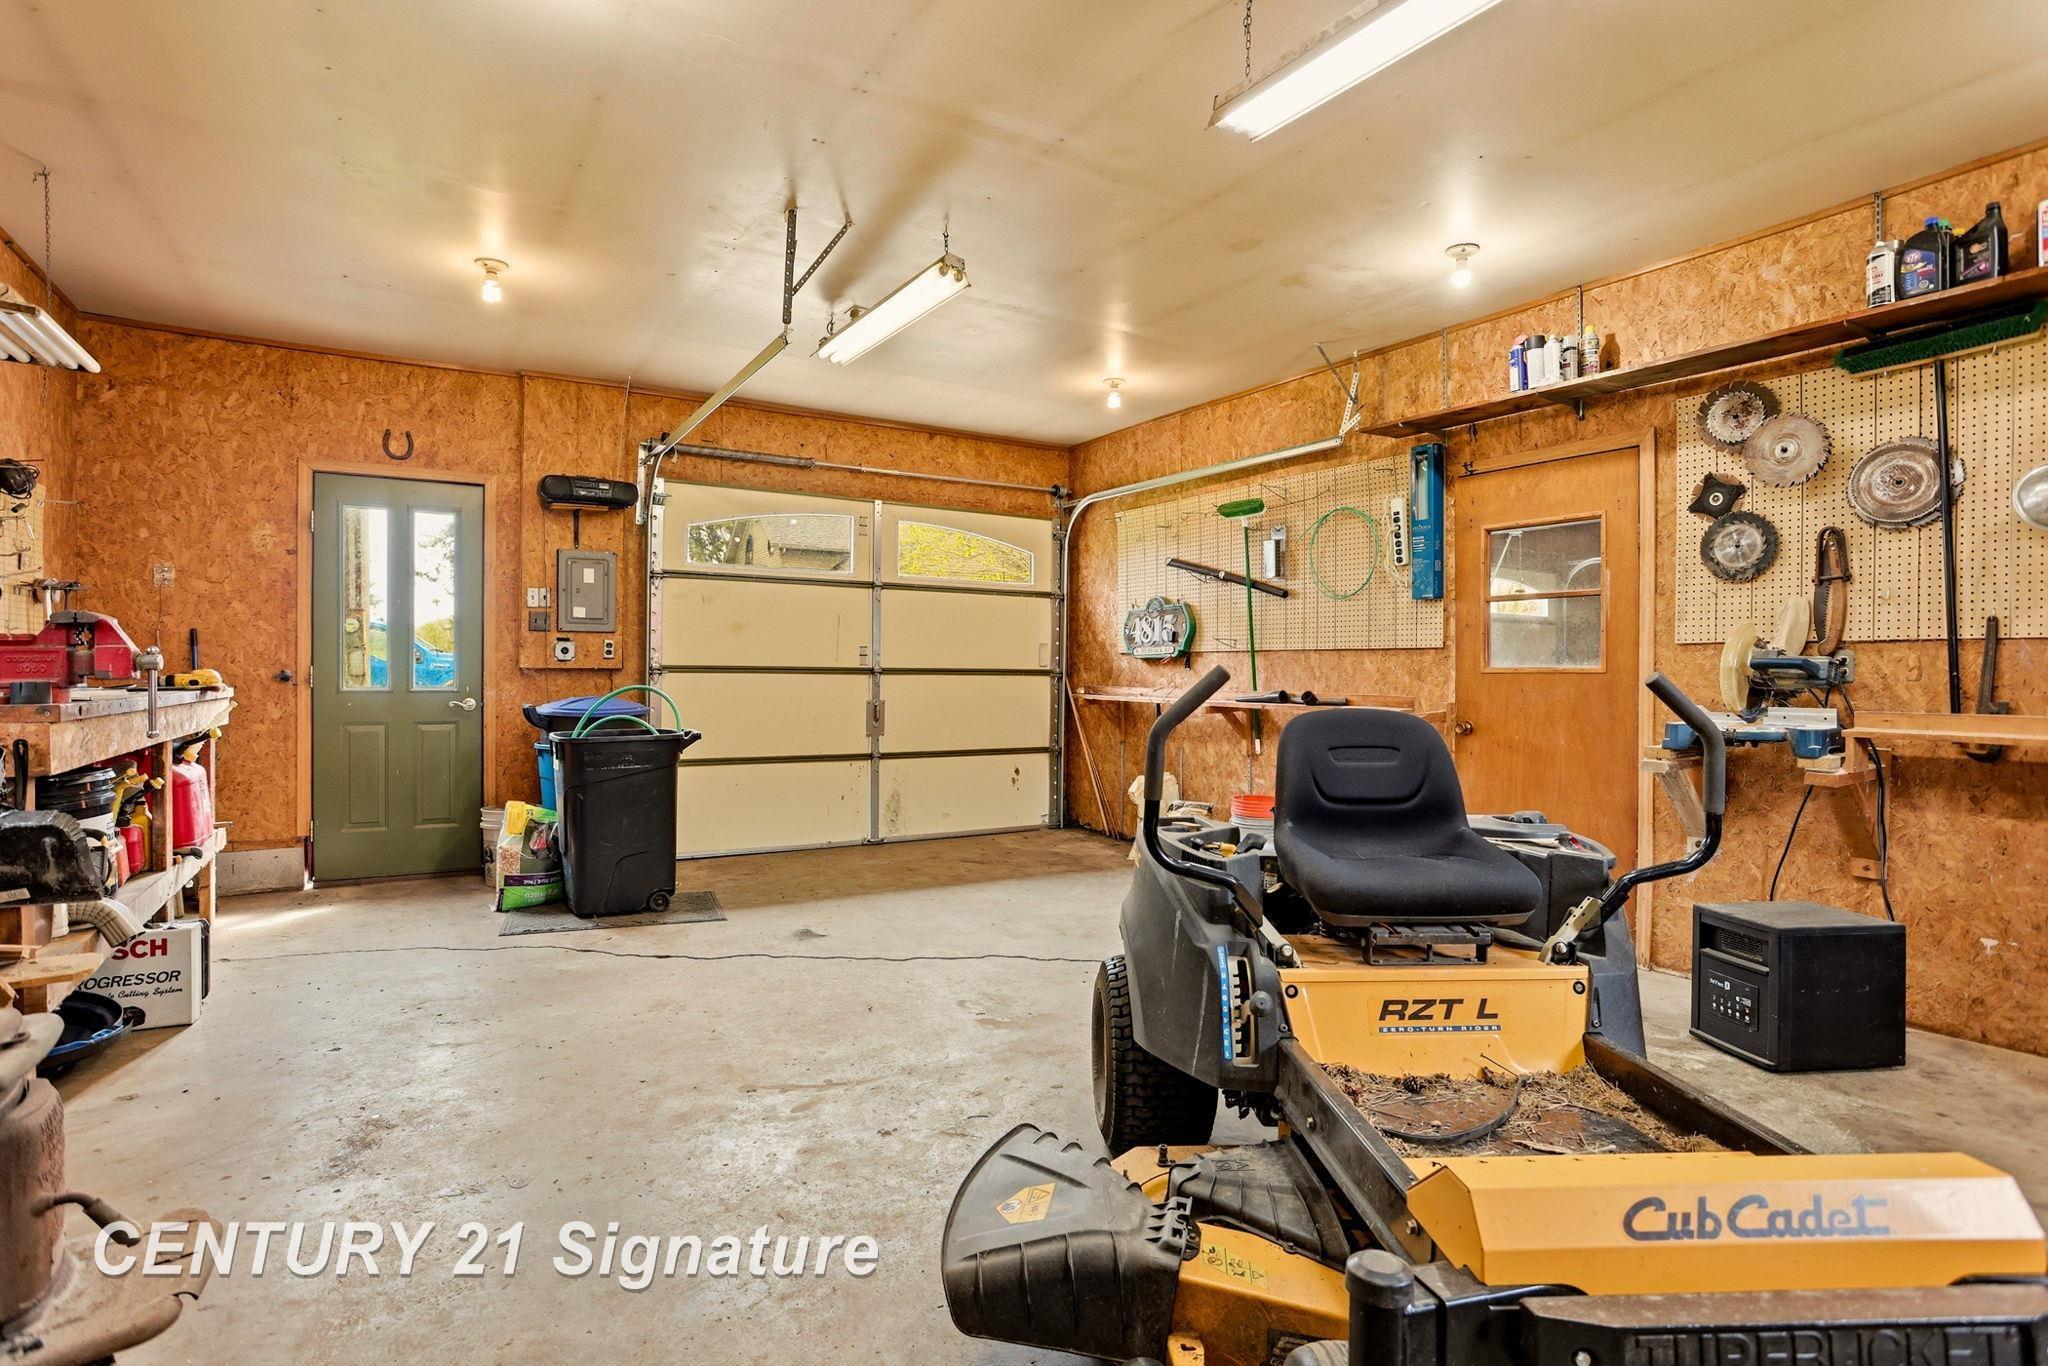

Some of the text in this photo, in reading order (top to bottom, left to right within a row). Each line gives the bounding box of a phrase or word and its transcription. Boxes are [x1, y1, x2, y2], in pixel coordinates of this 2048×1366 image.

[112, 938, 168, 960] SCH
[78, 970, 181, 990] OGRESSOR
[153, 986, 183, 996] System
[1378, 998, 1499, 1021] RZT L
